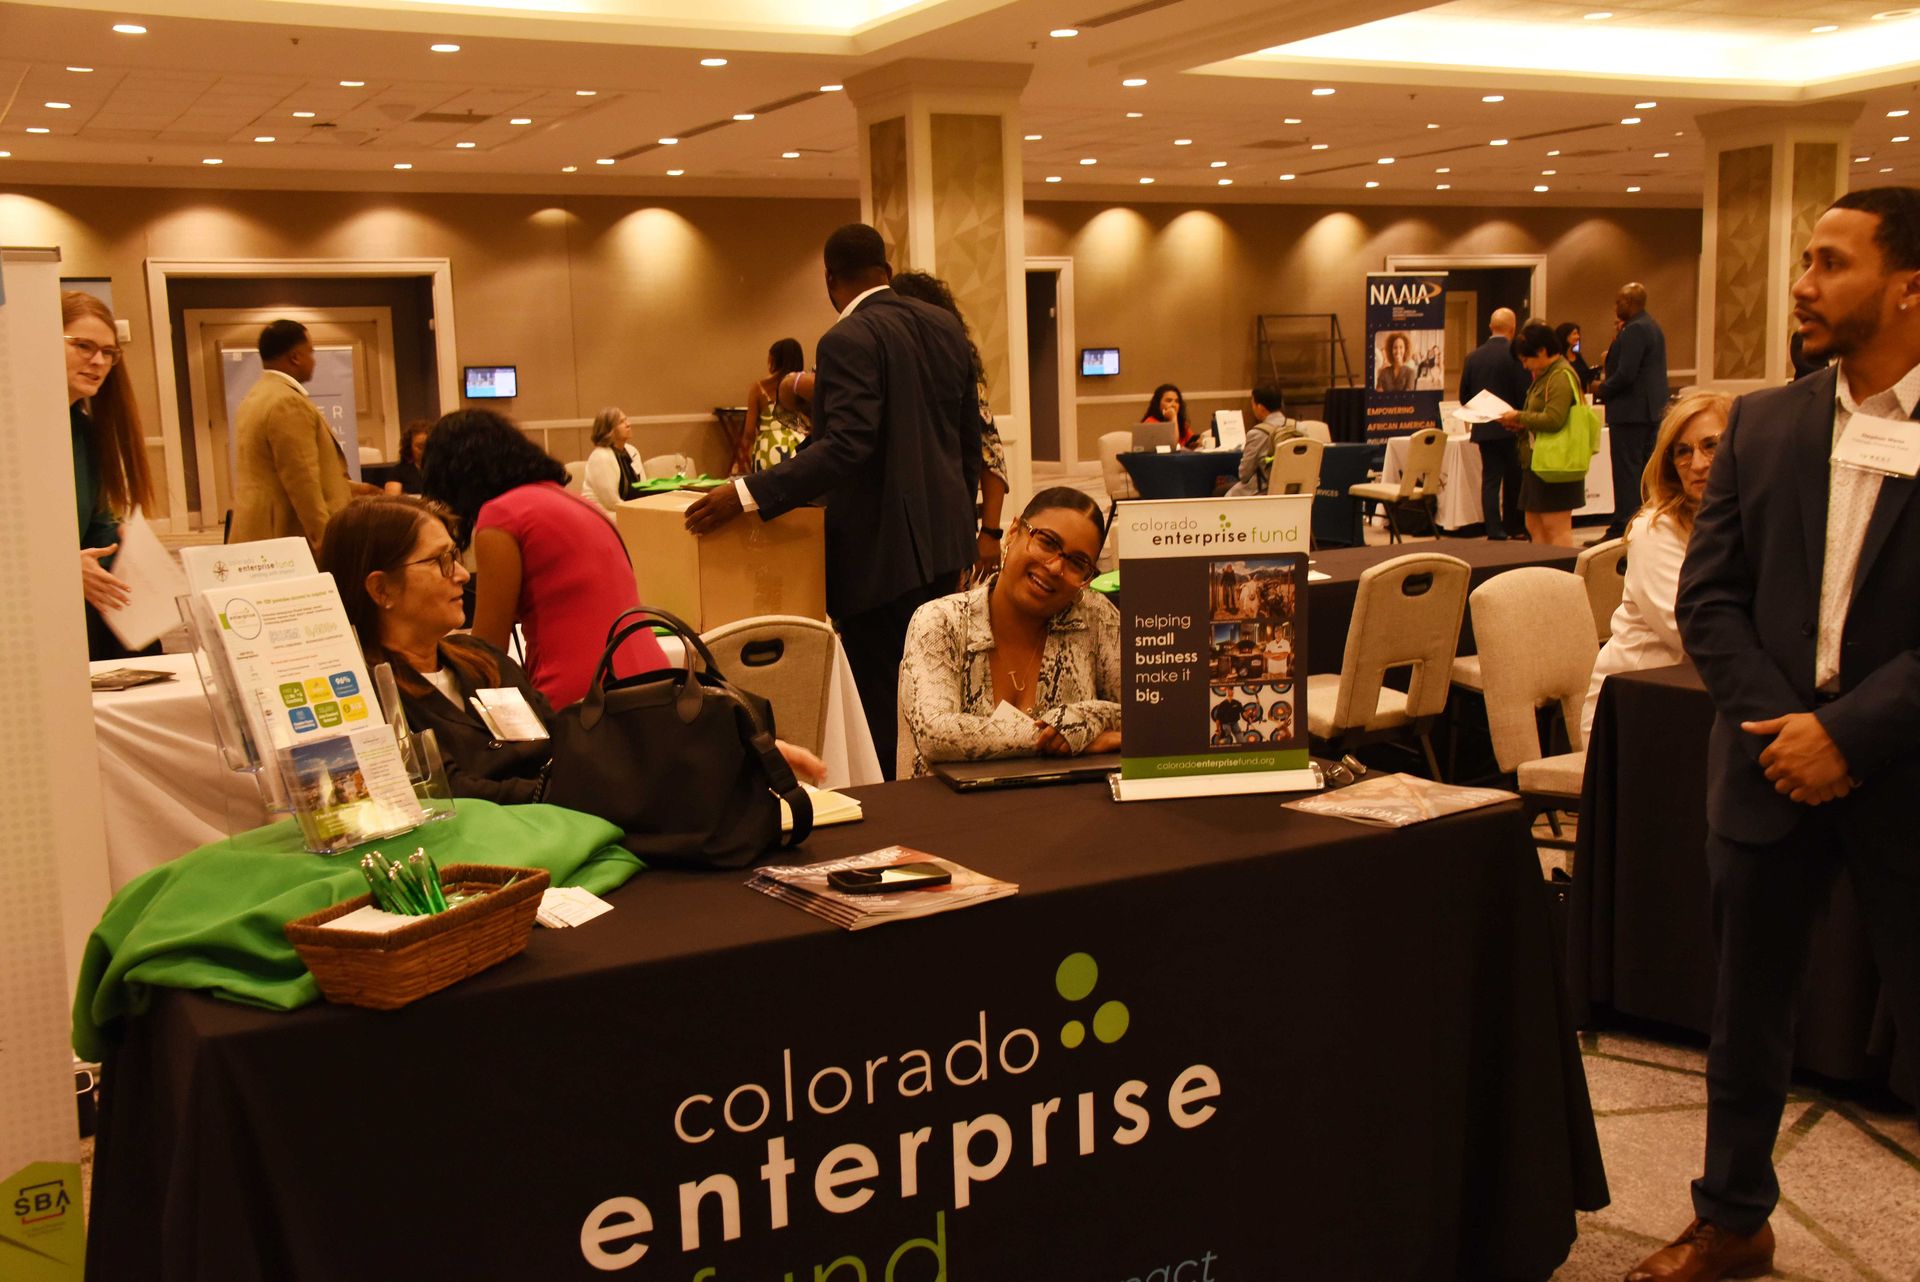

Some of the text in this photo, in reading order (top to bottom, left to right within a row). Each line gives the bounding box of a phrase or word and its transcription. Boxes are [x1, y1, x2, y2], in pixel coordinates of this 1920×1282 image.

[1367, 406, 1415, 416] EMPOWERING
[1367, 420, 1436, 431] AFRICAN AMERICAN
[1132, 517, 1198, 532] colorado
[1152, 526, 1298, 546] enterprise fund
[238, 563, 275, 573] enterprise
[1135, 614, 1191, 630] helping
[1135, 632, 1175, 647] small
[1135, 650, 1198, 665] business
[1135, 668, 1191, 683] make it
[1135, 689, 1164, 704] big.
[1157, 757, 1275, 770] coloradoenterprisefund.org
[674, 1010, 1040, 1143] colorado
[580, 1063, 1221, 1270] enterprise
[14, 1190, 71, 1216] SBA
